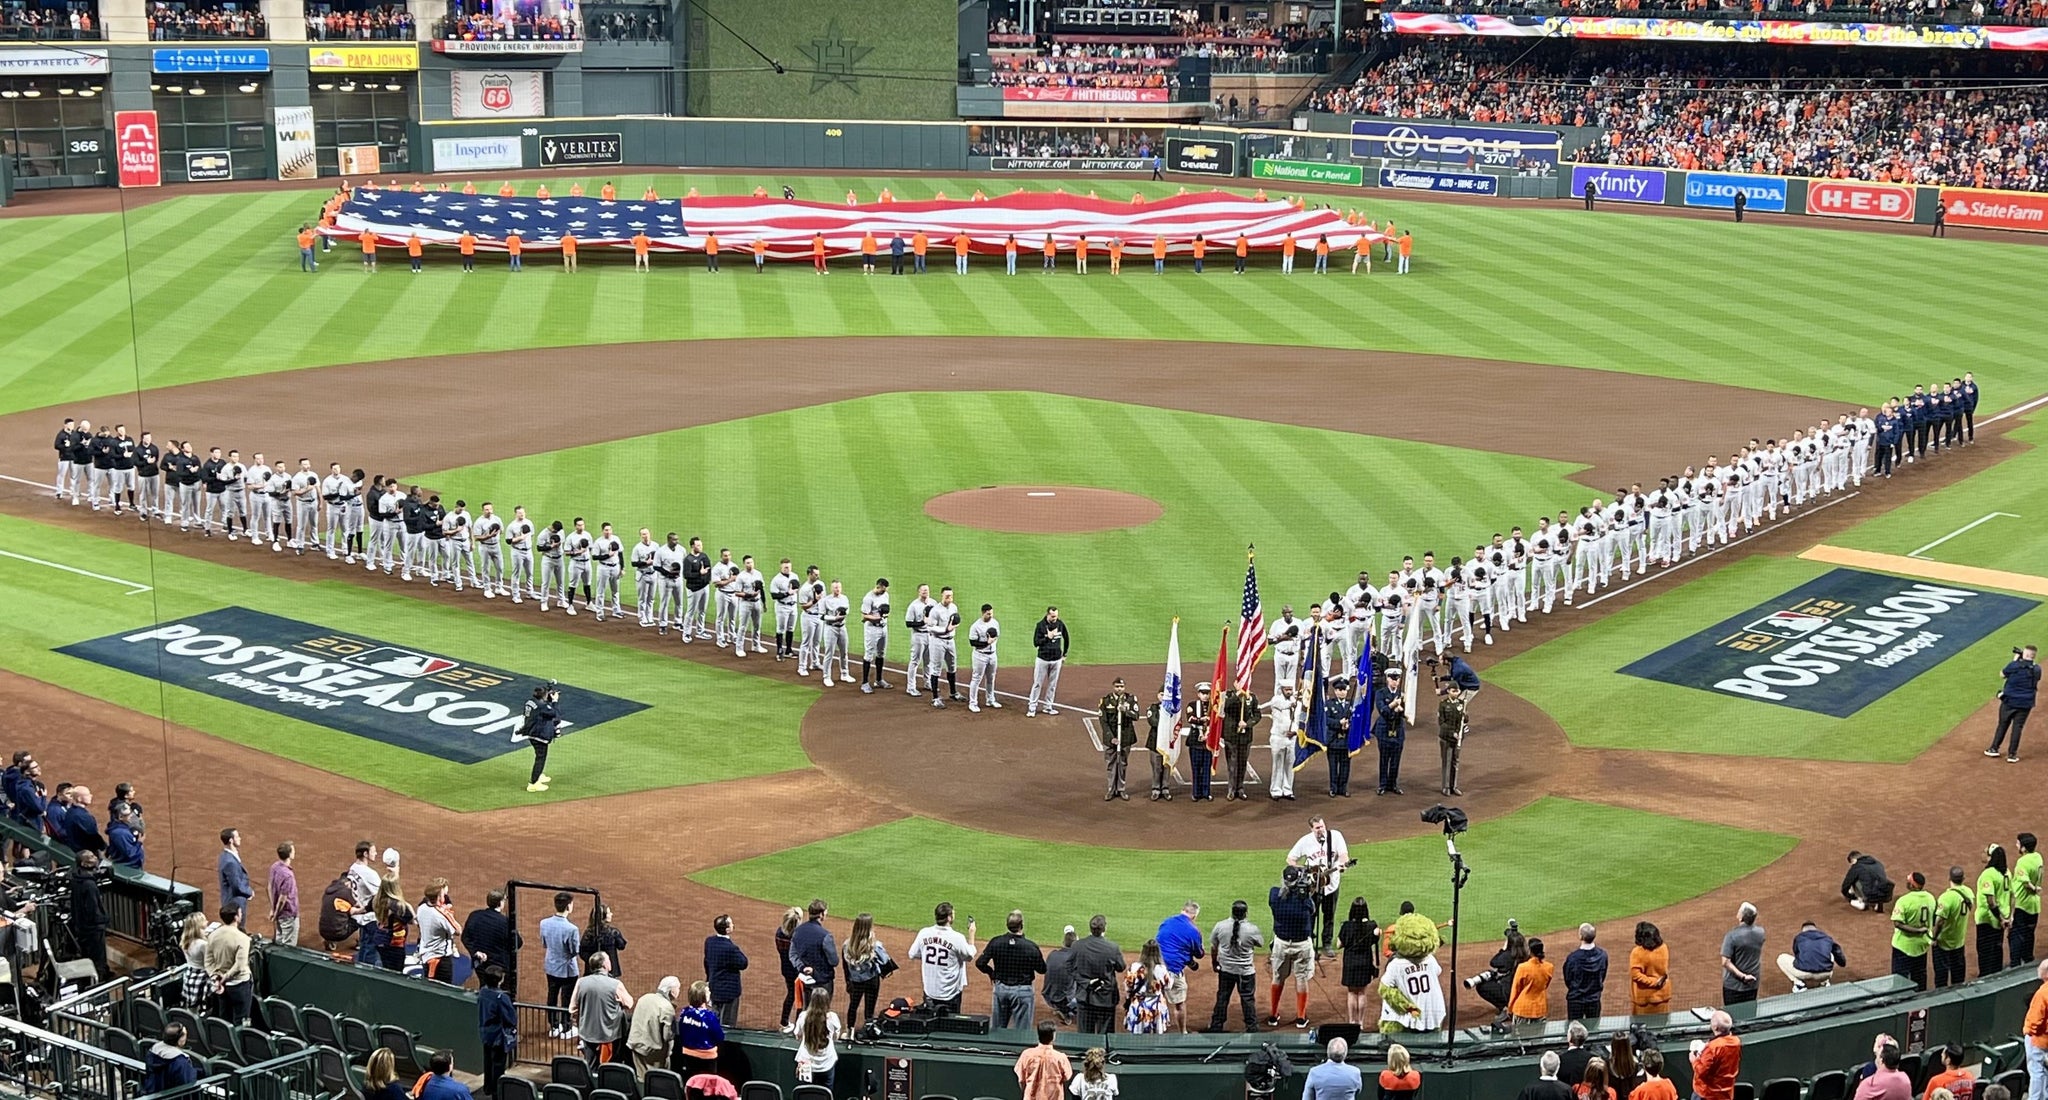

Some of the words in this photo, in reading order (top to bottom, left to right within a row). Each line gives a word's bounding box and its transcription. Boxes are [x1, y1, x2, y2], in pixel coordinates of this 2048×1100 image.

[1583, 18, 1607, 34] the
[1612, 20, 1648, 35] land
[1652, 20, 1668, 36] of
[1671, 20, 1698, 36] the
[1702, 20, 1736, 38] free
[1741, 21, 1773, 39] and
[1777, 23, 1804, 40] the
[1809, 23, 1861, 41] home
[1865, 24, 1885, 42] of
[1889, 26, 1918, 42] the
[460, 42, 501, 51] PROVIDING
[33, 58, 80, 67] AMERICA
[347, 54, 373, 66] PAPA
[375, 54, 412, 66] JOHN'S
[487, 90, 507, 104] 66
[1072, 89, 1137, 101] #HITTHEBUDS
[279, 130, 311, 141] WM
[71, 141, 98, 153] 366
[455, 143, 508, 158] Insperity
[560, 141, 616, 153] VERITEX
[1422, 134, 1521, 158] LEXUS
[122, 151, 155, 164] Auto
[564, 152, 597, 160] COMMUNITY
[1484, 153, 1507, 164] 370
[122, 163, 154, 173] Anything
[1007, 160, 1071, 169] NITTOTIRE.COM
[1081, 160, 1145, 170] NITTOTIRE.COM
[1180, 161, 1219, 170] CHEVROLET
[191, 169, 229, 177] CHEVROLET
[1274, 164, 1309, 177] National
[1311, 169, 1325, 179] Car
[1325, 170, 1351, 181] Rental
[1477, 180, 1490, 190] LIFE
[1589, 170, 1648, 198] xfinity
[1705, 184, 1784, 201] HONDA
[1821, 189, 1902, 212] H-E-B
[1970, 201, 2007, 219] State
[2007, 203, 2044, 221] Farm
[1713, 583, 1979, 701] POSTSEASON
[1864, 630, 1945, 668] loanDepot
[122, 623, 574, 743] POSTSEASON
[207, 671, 345, 710] loanDepot
[922, 936, 953, 950] HOWARD
[925, 945, 949, 967] 22
[1404, 963, 1428, 975] ORBIT
[1407, 974, 1431, 995] 00
